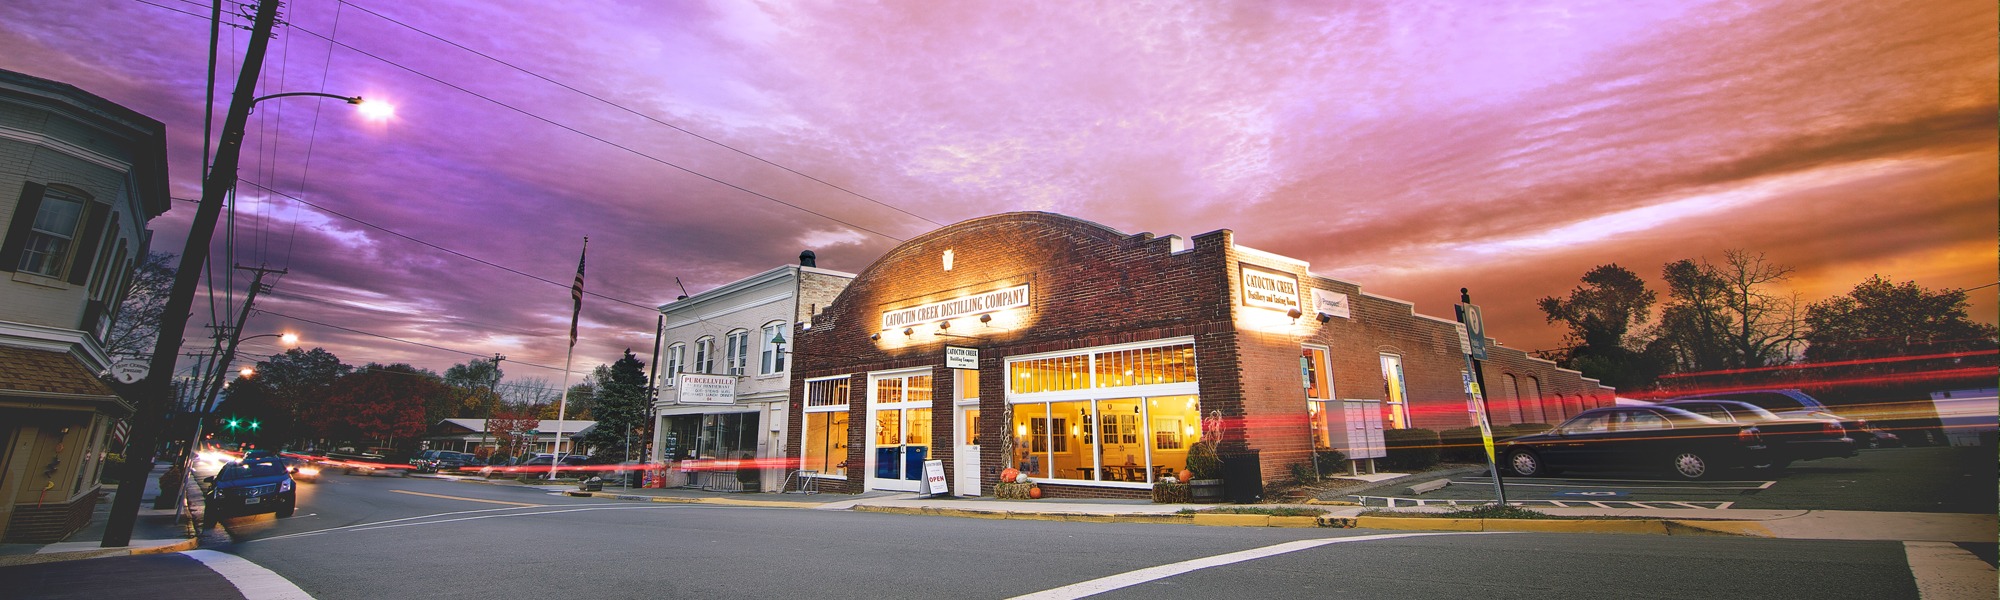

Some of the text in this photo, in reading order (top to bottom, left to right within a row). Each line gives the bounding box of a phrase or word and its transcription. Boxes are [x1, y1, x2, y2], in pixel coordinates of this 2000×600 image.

[1246, 274, 1295, 295] CATOCTIN CREEK
[1247, 289, 1266, 303] Distillery
[1273, 294, 1286, 306] Tasting
[1286, 297, 1297, 306] Room
[885, 288, 1025, 327] CATOCTIN CREEK DISTILLING COMPANY
[947, 348, 977, 357] CATOCTIN CREEK
[684, 377, 734, 385] PURCELLVILLE
[929, 475, 945, 483] OPEN
